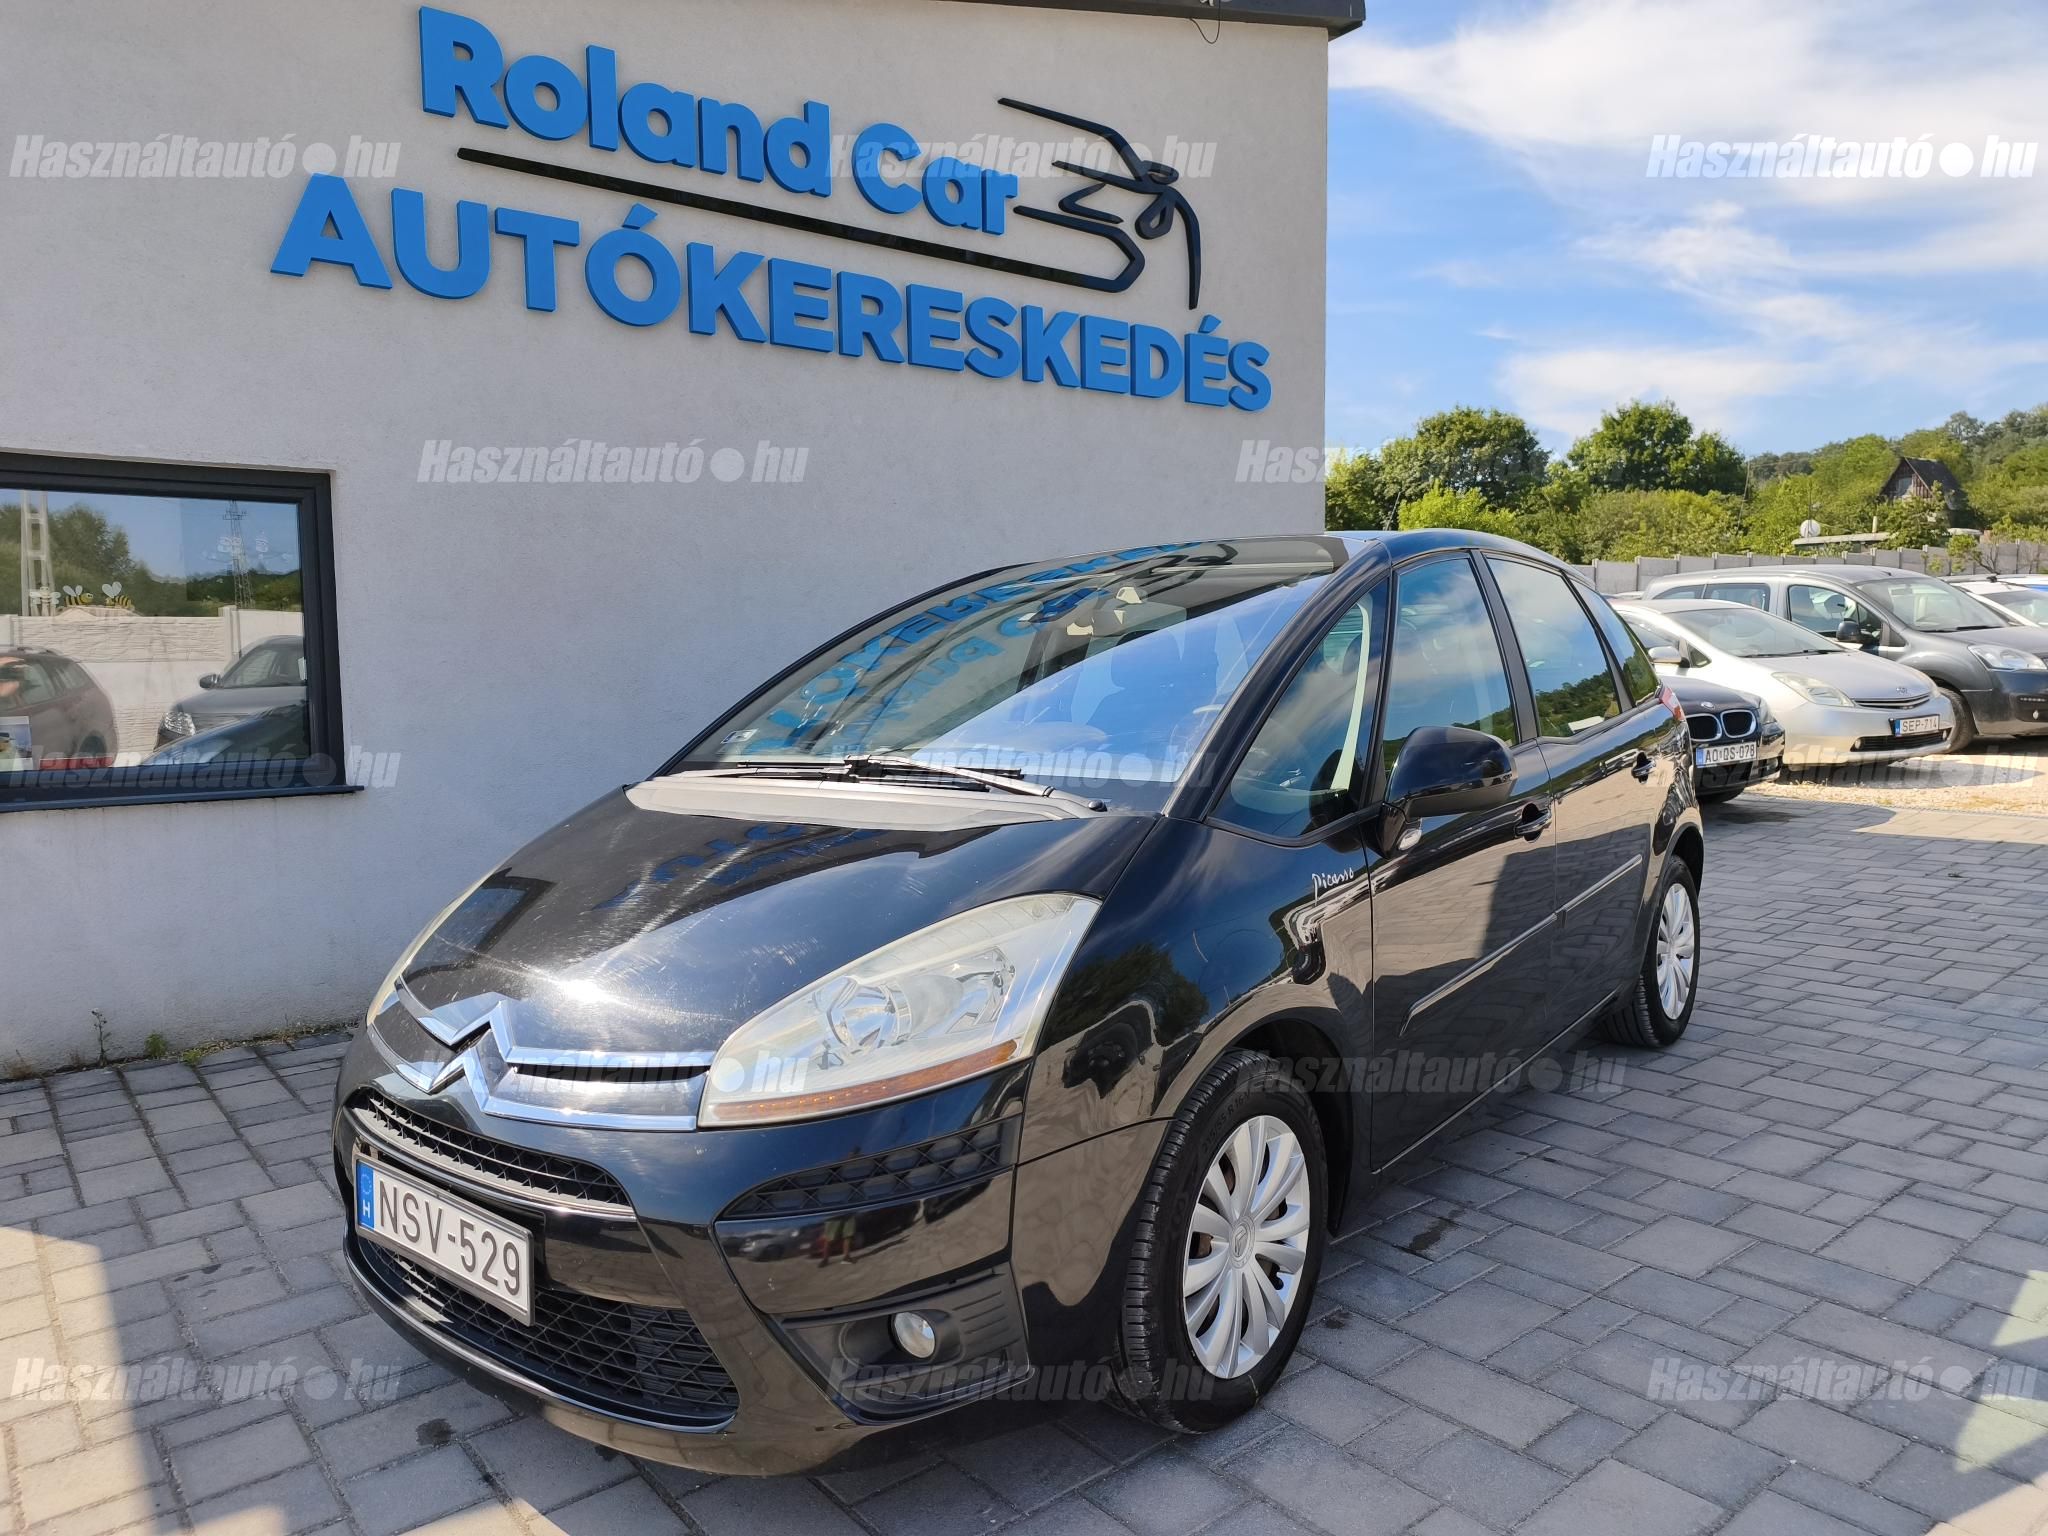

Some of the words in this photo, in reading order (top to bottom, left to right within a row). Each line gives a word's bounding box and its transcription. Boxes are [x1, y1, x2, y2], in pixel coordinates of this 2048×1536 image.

[417, 5, 831, 198] Roland
[851, 122, 1018, 236] Car
[270, 172, 1273, 413] AUTÓKERESKEDÉS
[1902, 717, 1937, 733] SEP-714
[362, 1199, 371, 1219] H
[379, 1180, 520, 1296] NSV-529
